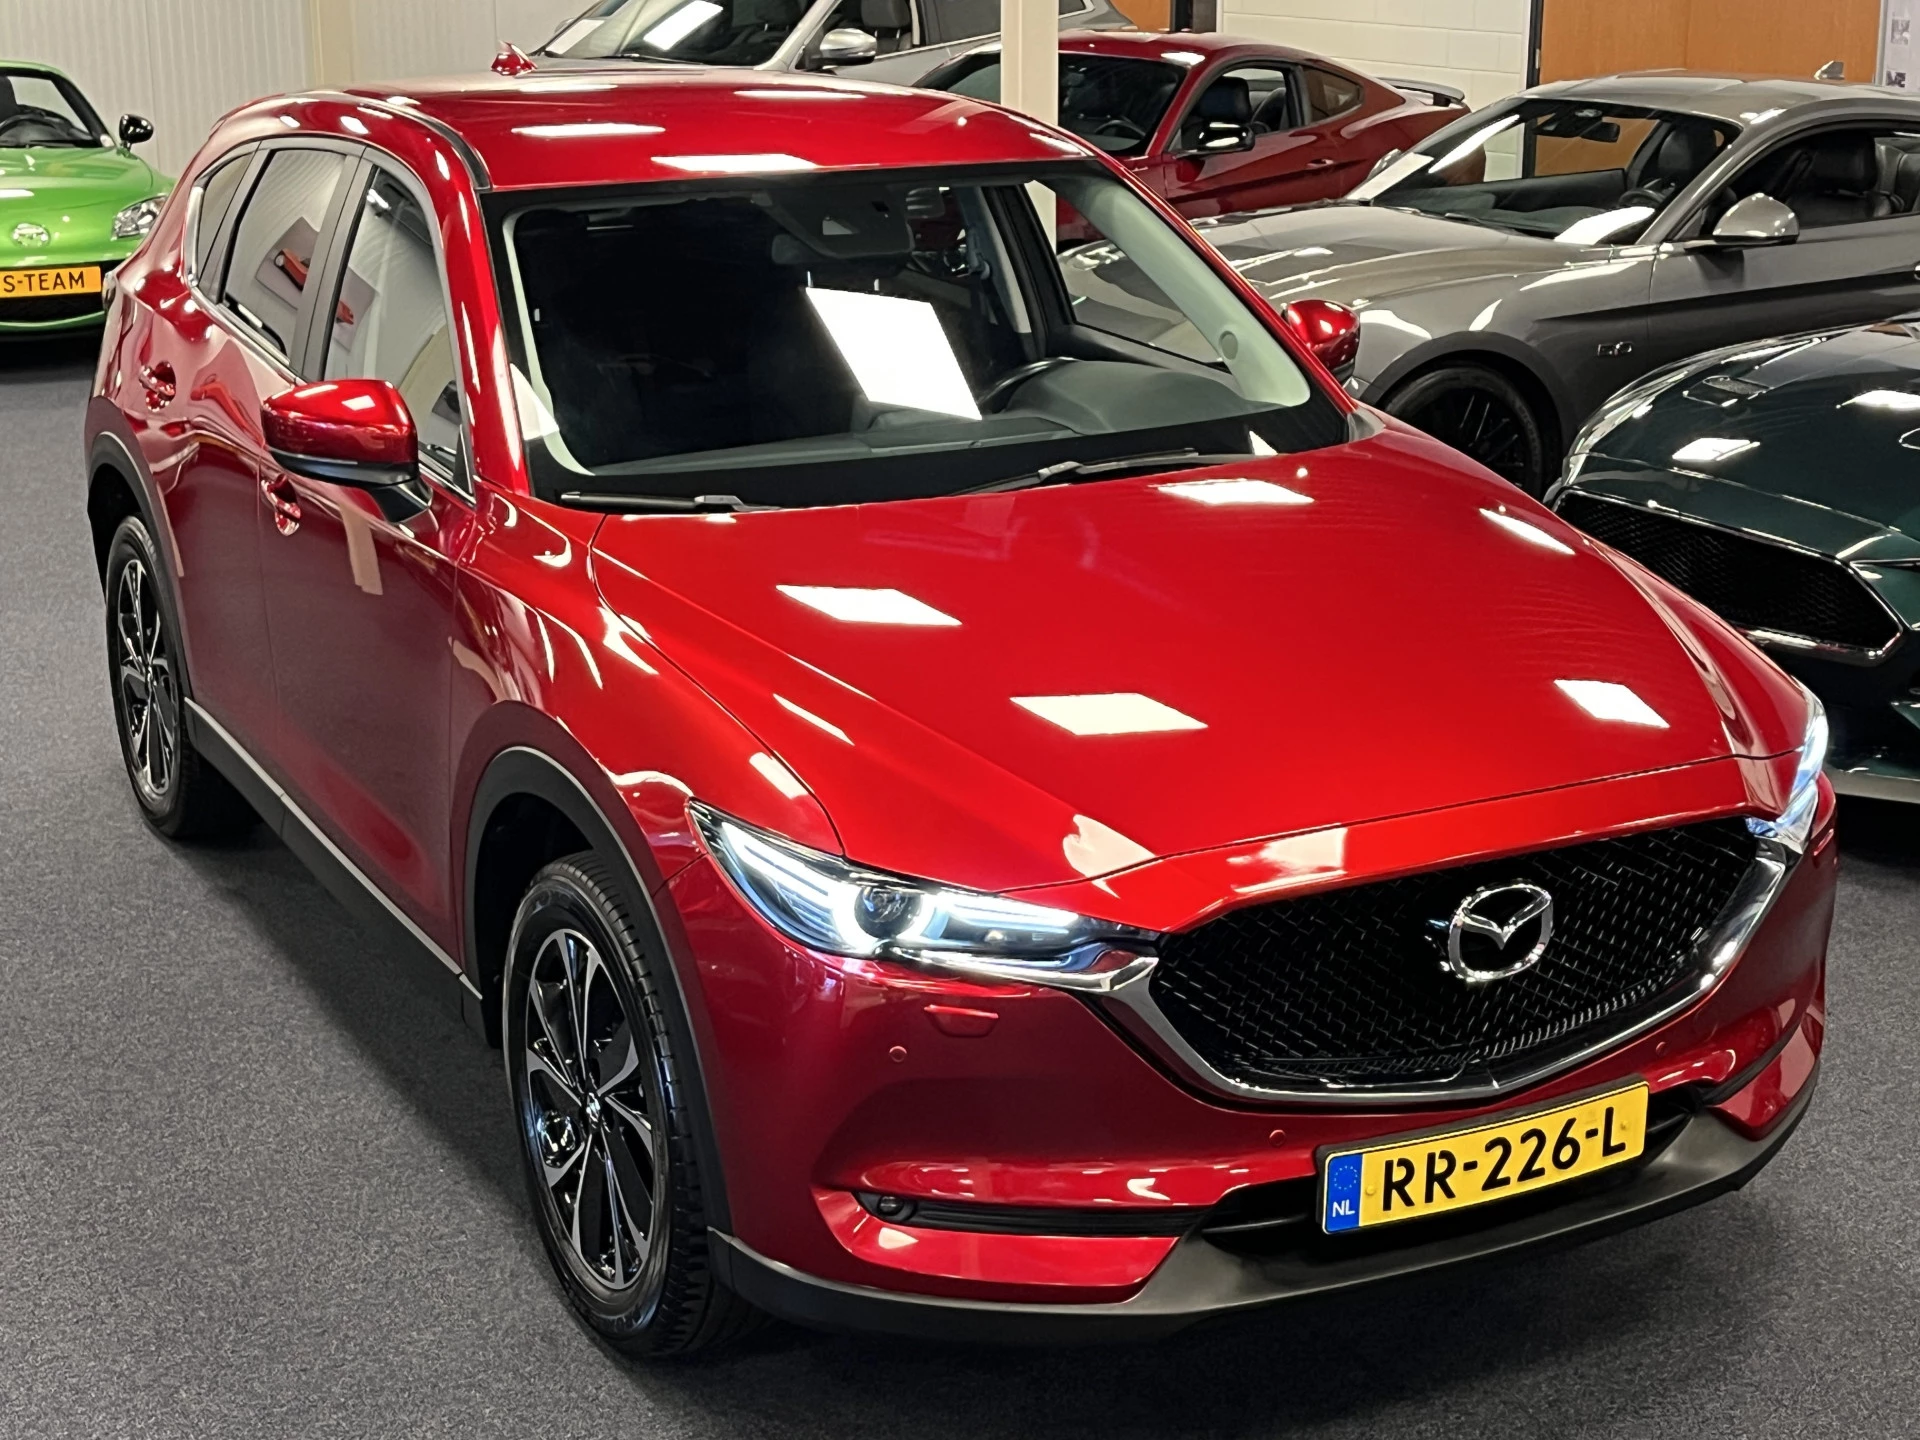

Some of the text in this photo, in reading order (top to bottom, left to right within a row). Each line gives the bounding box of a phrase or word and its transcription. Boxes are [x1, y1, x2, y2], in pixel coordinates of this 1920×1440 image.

[3, 271, 85, 292] S-TEAM
[1382, 1106, 1626, 1212] RR-226-L
[1332, 1200, 1356, 1218] NL
